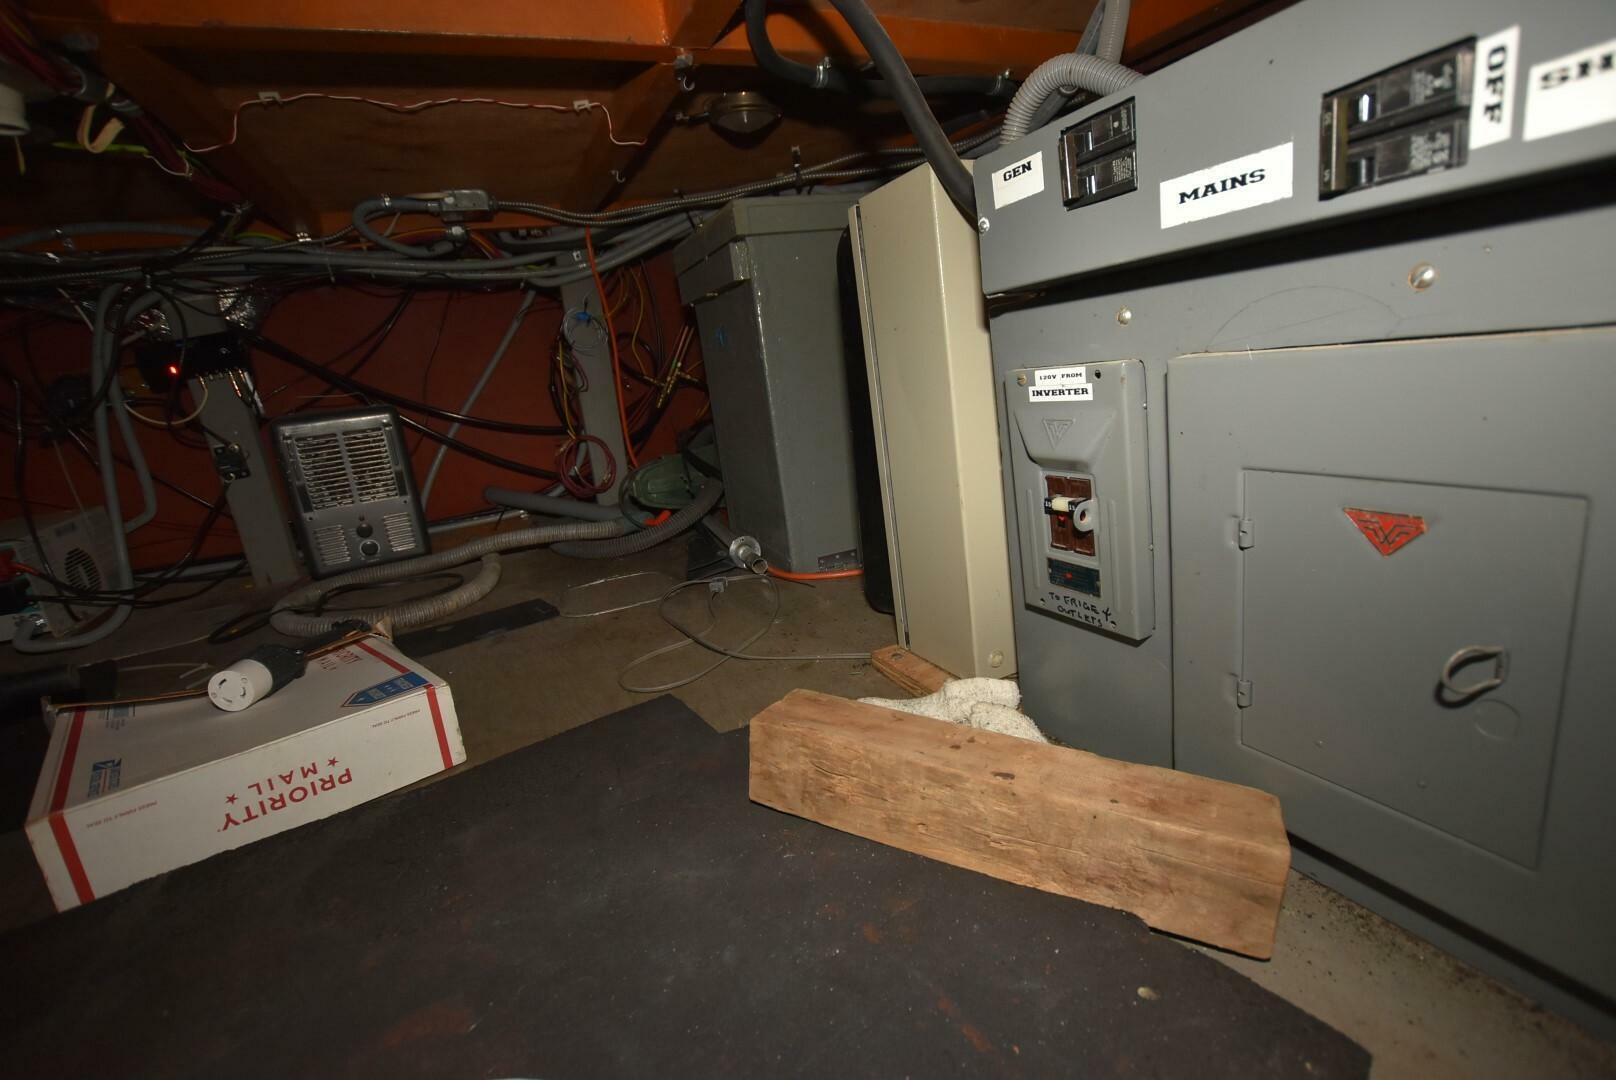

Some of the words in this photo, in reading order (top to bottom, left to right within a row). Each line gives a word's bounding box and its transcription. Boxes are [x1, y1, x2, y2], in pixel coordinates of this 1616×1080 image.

[1483, 45, 1508, 124] OFF
[1002, 160, 1032, 184] GEN
[1178, 167, 1266, 205] MAINS
[1032, 387, 1089, 397] INVERTER
[1057, 605, 1105, 629] OUTLETS
[247, 762, 318, 796] MAIL
[221, 768, 353, 832] PRIORITY
